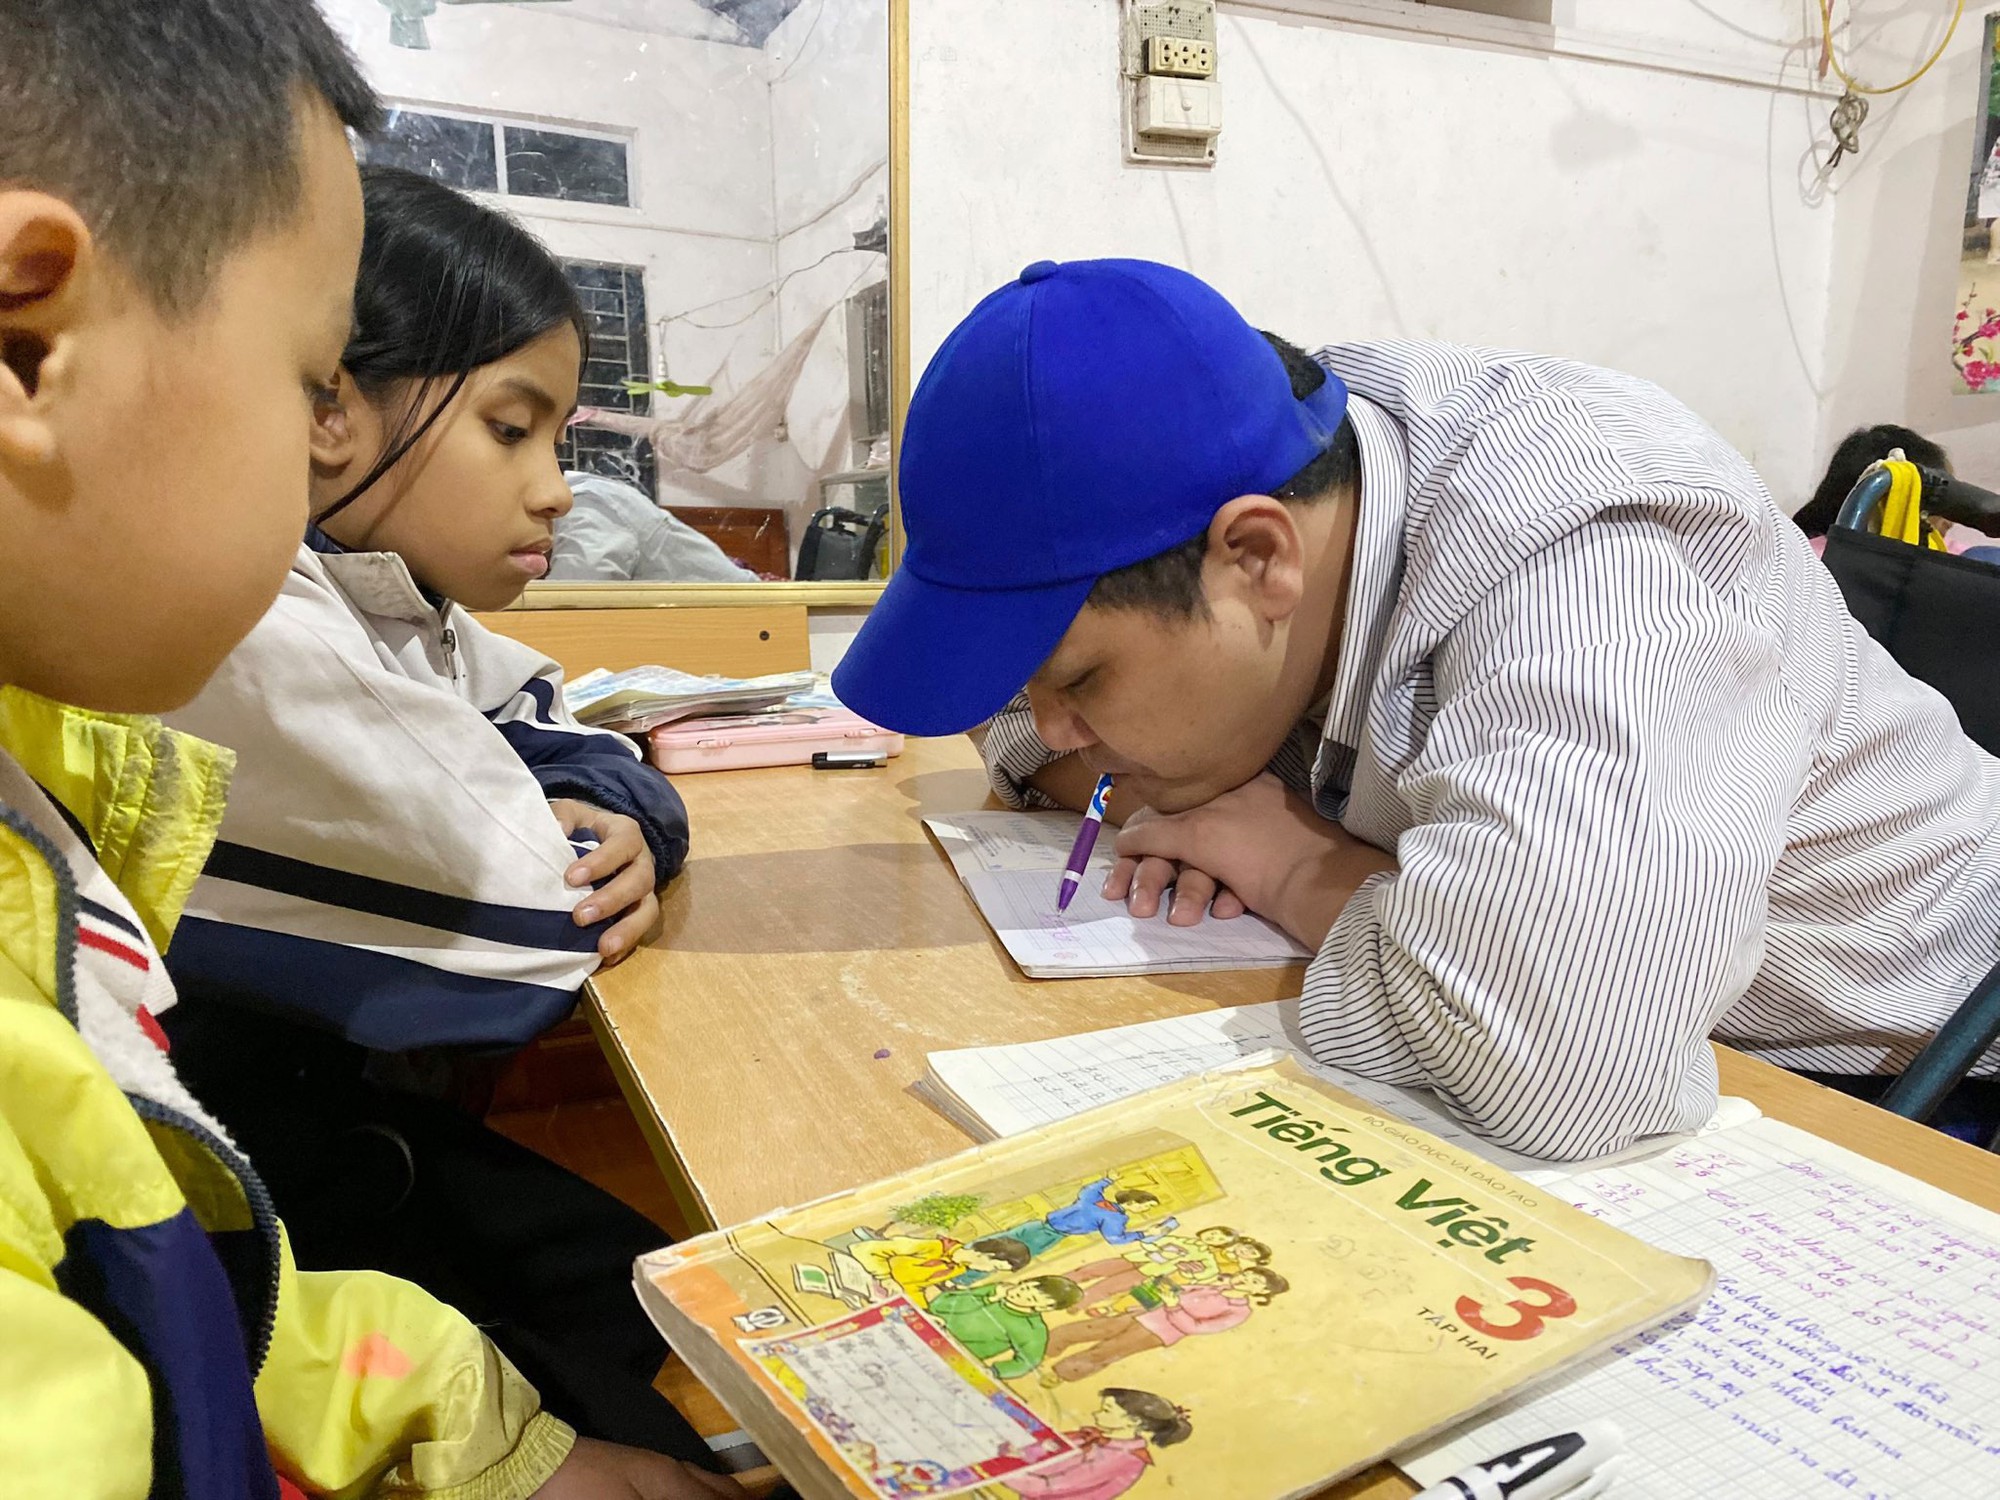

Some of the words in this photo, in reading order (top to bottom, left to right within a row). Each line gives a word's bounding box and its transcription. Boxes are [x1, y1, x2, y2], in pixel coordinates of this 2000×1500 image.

[1229, 1091, 1393, 1186] Tiếng
[1395, 1178, 1537, 1265] Việt
[1455, 1276, 1578, 1341] 3
[1457, 1335, 1498, 1360] HAI
